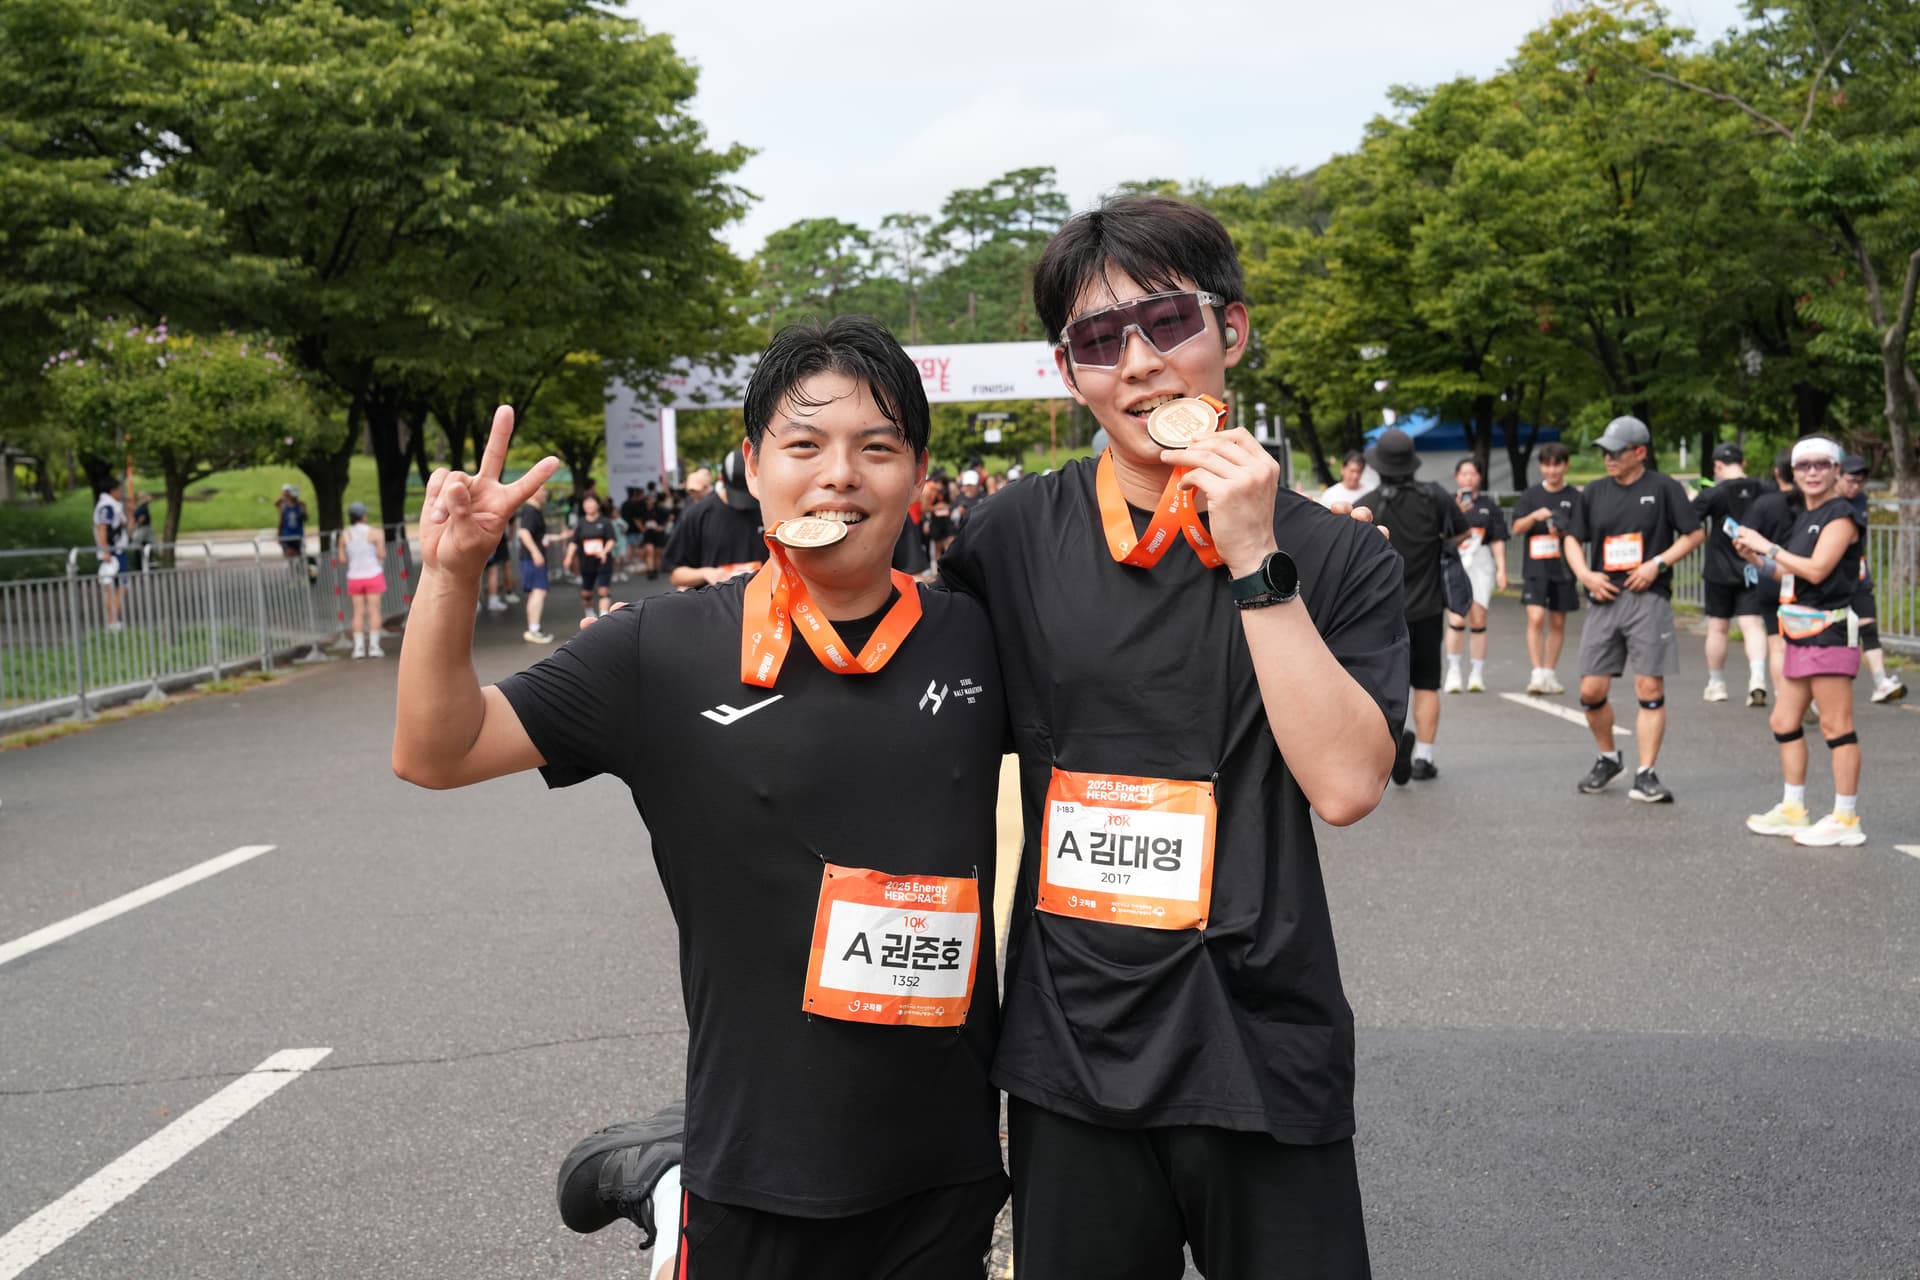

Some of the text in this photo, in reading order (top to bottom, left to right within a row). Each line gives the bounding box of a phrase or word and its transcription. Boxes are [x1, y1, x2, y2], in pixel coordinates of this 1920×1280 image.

[1087, 780, 1154, 795] 2025 Energy
[1057, 830, 1182, 872] A 김대영
[1101, 872, 1131, 885] 2017
[885, 881, 948, 896] 2025 Energy
[903, 916, 928, 929] 10K
[842, 932, 962, 971] A 권준호
[892, 975, 920, 987] 1352
